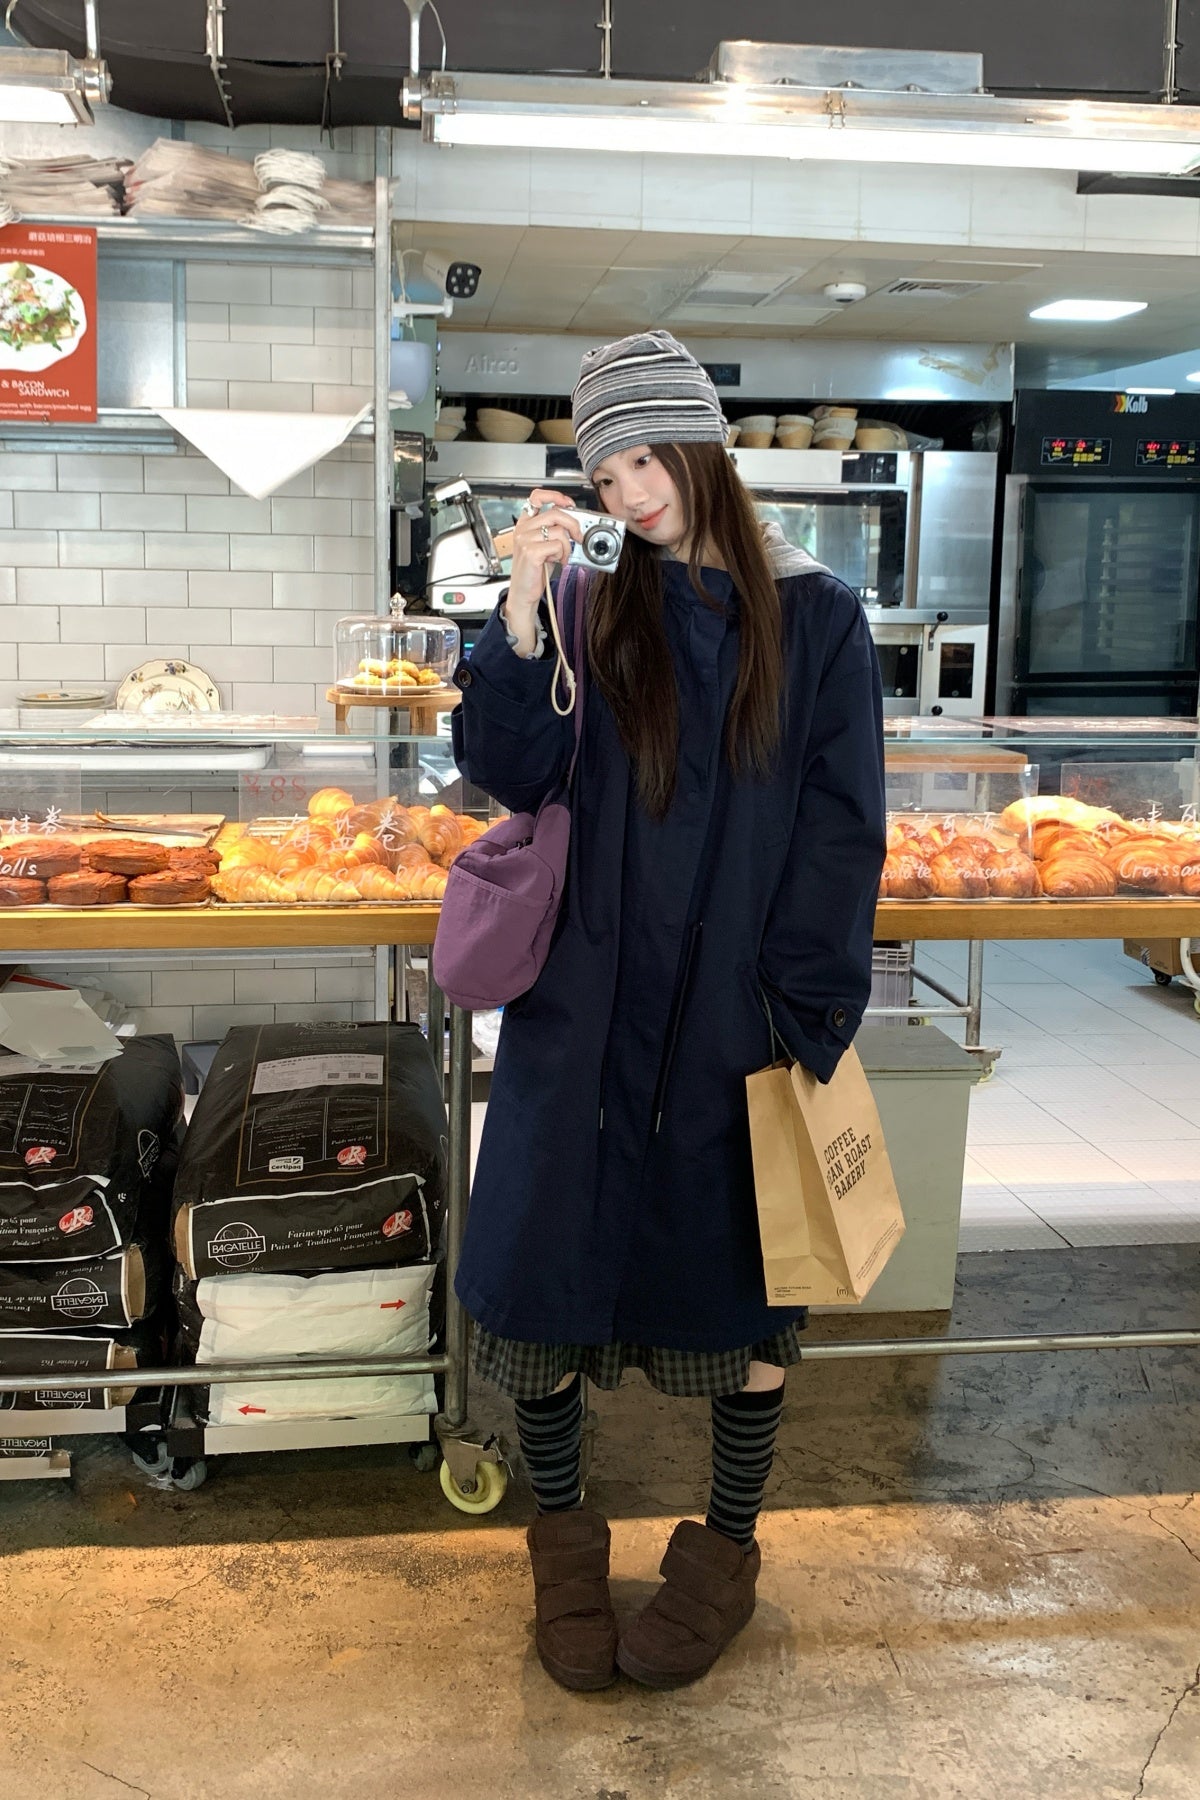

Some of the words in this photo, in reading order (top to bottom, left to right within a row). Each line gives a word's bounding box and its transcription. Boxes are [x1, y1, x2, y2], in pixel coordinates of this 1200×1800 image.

[464, 353, 520, 375] Airco
[1, 379, 10, 389] &
[11, 379, 45, 390] BACON
[18, 387, 70, 398] SANDWICH
[1125, 395, 1149, 413] Kolb
[0, 805, 66, 837] 桂卷
[823, 1127, 856, 1165] COFFEE
[843, 1134, 872, 1168] ROAST
[834, 1159, 866, 1200] BAKERY
[20, 1225, 56, 1236] Française
[287, 1228, 315, 1240] Farine
[316, 1226, 333, 1239] type
[333, 1224, 344, 1234] 65
[345, 1222, 364, 1233] pour
[212, 1239, 262, 1254] BAGATELLE
[270, 1241, 291, 1251] Pain
[293, 1240, 303, 1249] de
[305, 1236, 341, 1247] Tradition
[344, 1229, 380, 1242] Française
[28, 1296, 47, 1304] Pain
[56, 1295, 103, 1307] BAGATELLE
[39, 1390, 87, 1399] BAGATELLE
[1, 1438, 48, 1448] BAGATELLE
